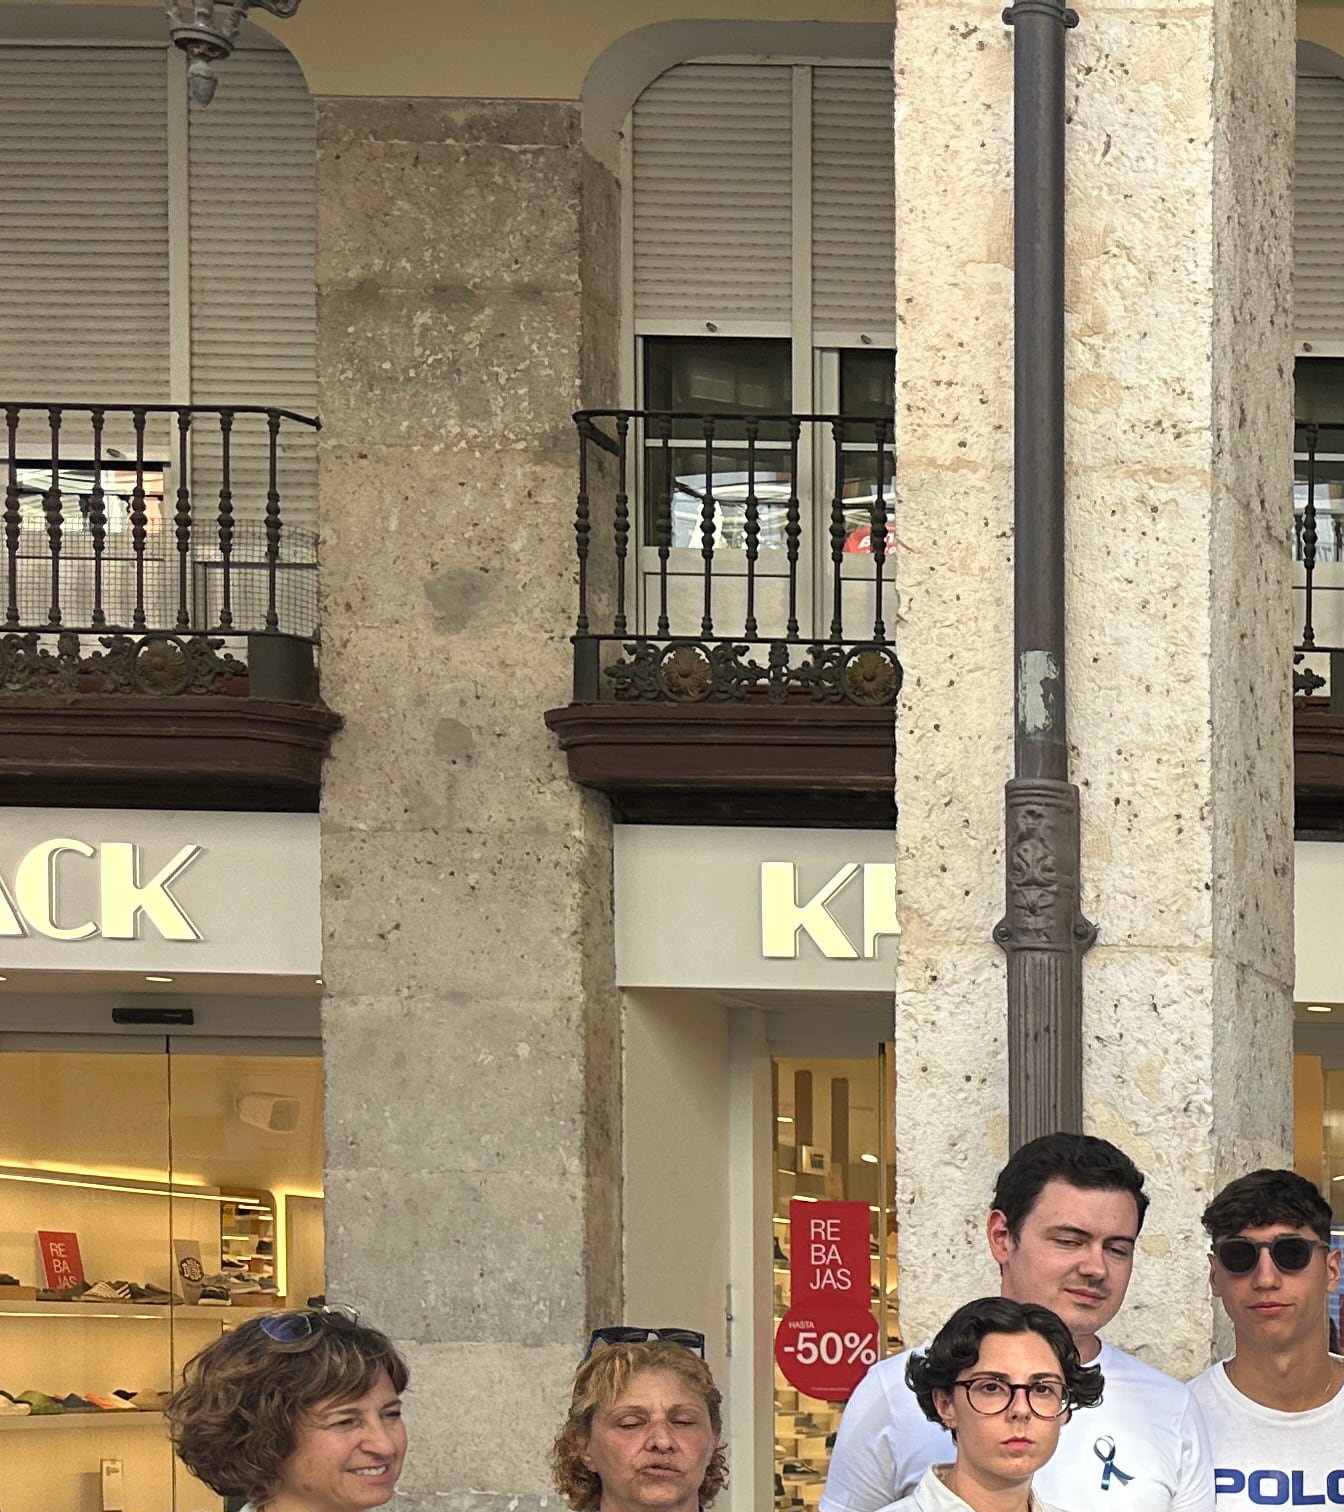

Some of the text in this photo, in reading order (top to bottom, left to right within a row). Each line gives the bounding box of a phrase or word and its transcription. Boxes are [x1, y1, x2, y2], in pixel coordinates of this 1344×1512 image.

[809, 1219, 841, 1241] RE
[50, 1242, 66, 1258] RE
[810, 1243, 843, 1265] BA
[52, 1259, 70, 1274] BA
[809, 1268, 852, 1290] JAS
[788, 1321, 815, 1329] HASTA
[783, 1331, 877, 1365] -50%
